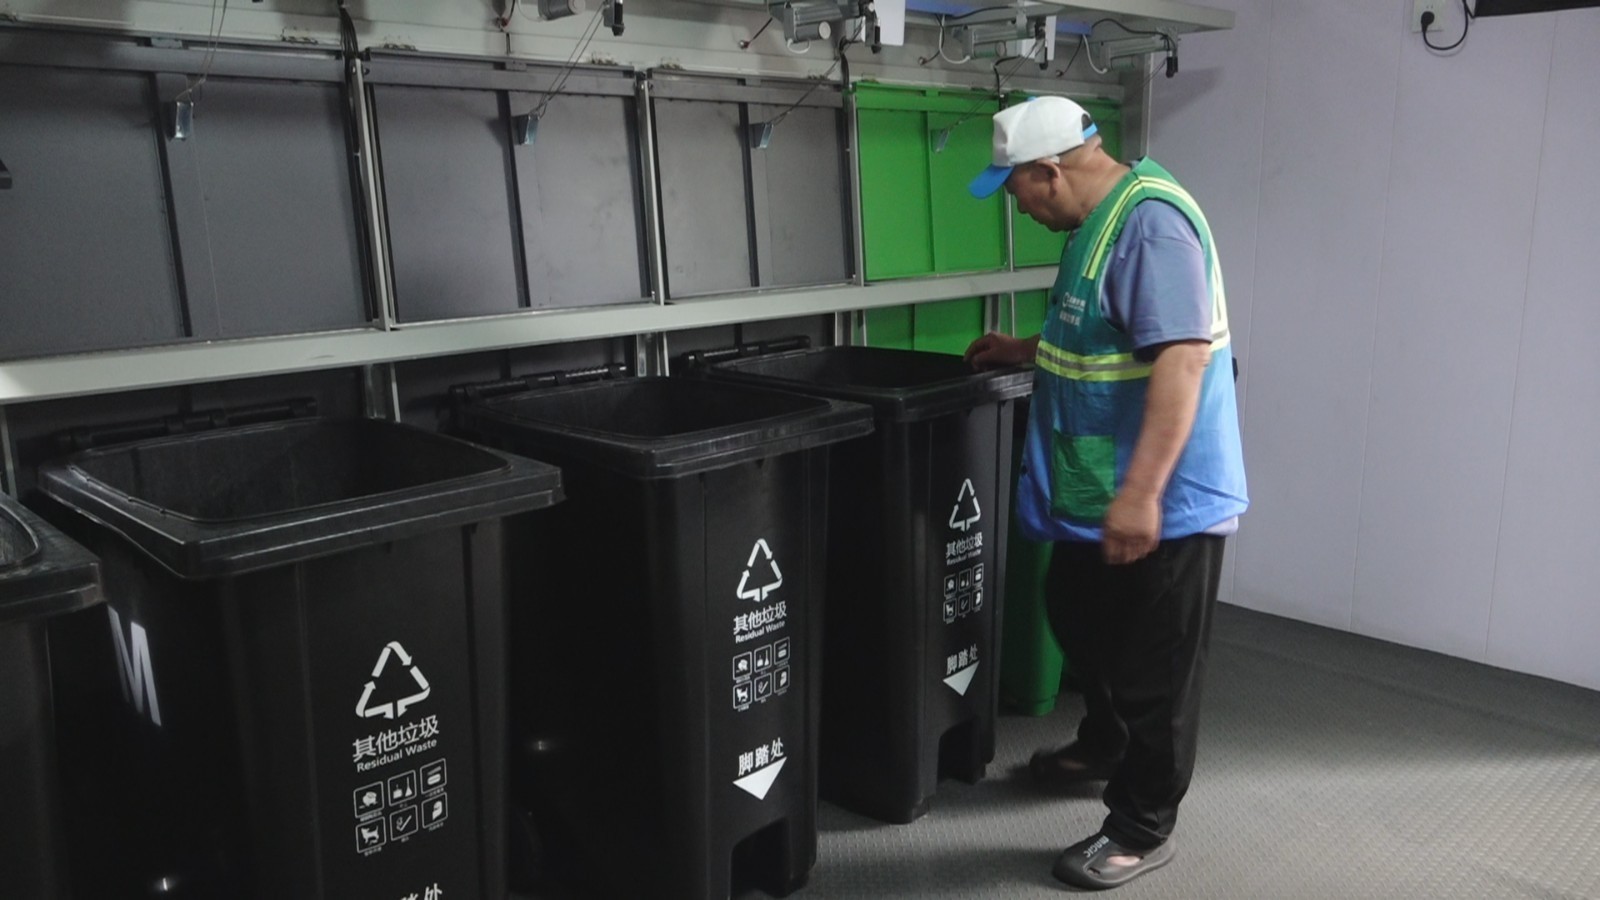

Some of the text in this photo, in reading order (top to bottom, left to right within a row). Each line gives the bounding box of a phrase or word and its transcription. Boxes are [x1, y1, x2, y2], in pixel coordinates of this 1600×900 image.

[946, 532, 983, 558] 其他垃圾
[733, 601, 787, 635] 其他垃圾
[735, 621, 785, 643] Residual Waste
[946, 644, 977, 675] 脚踏处
[352, 715, 439, 762] 其他垃圾
[357, 739, 437, 772] Residual Waste
[737, 737, 784, 776] 脚踏处
